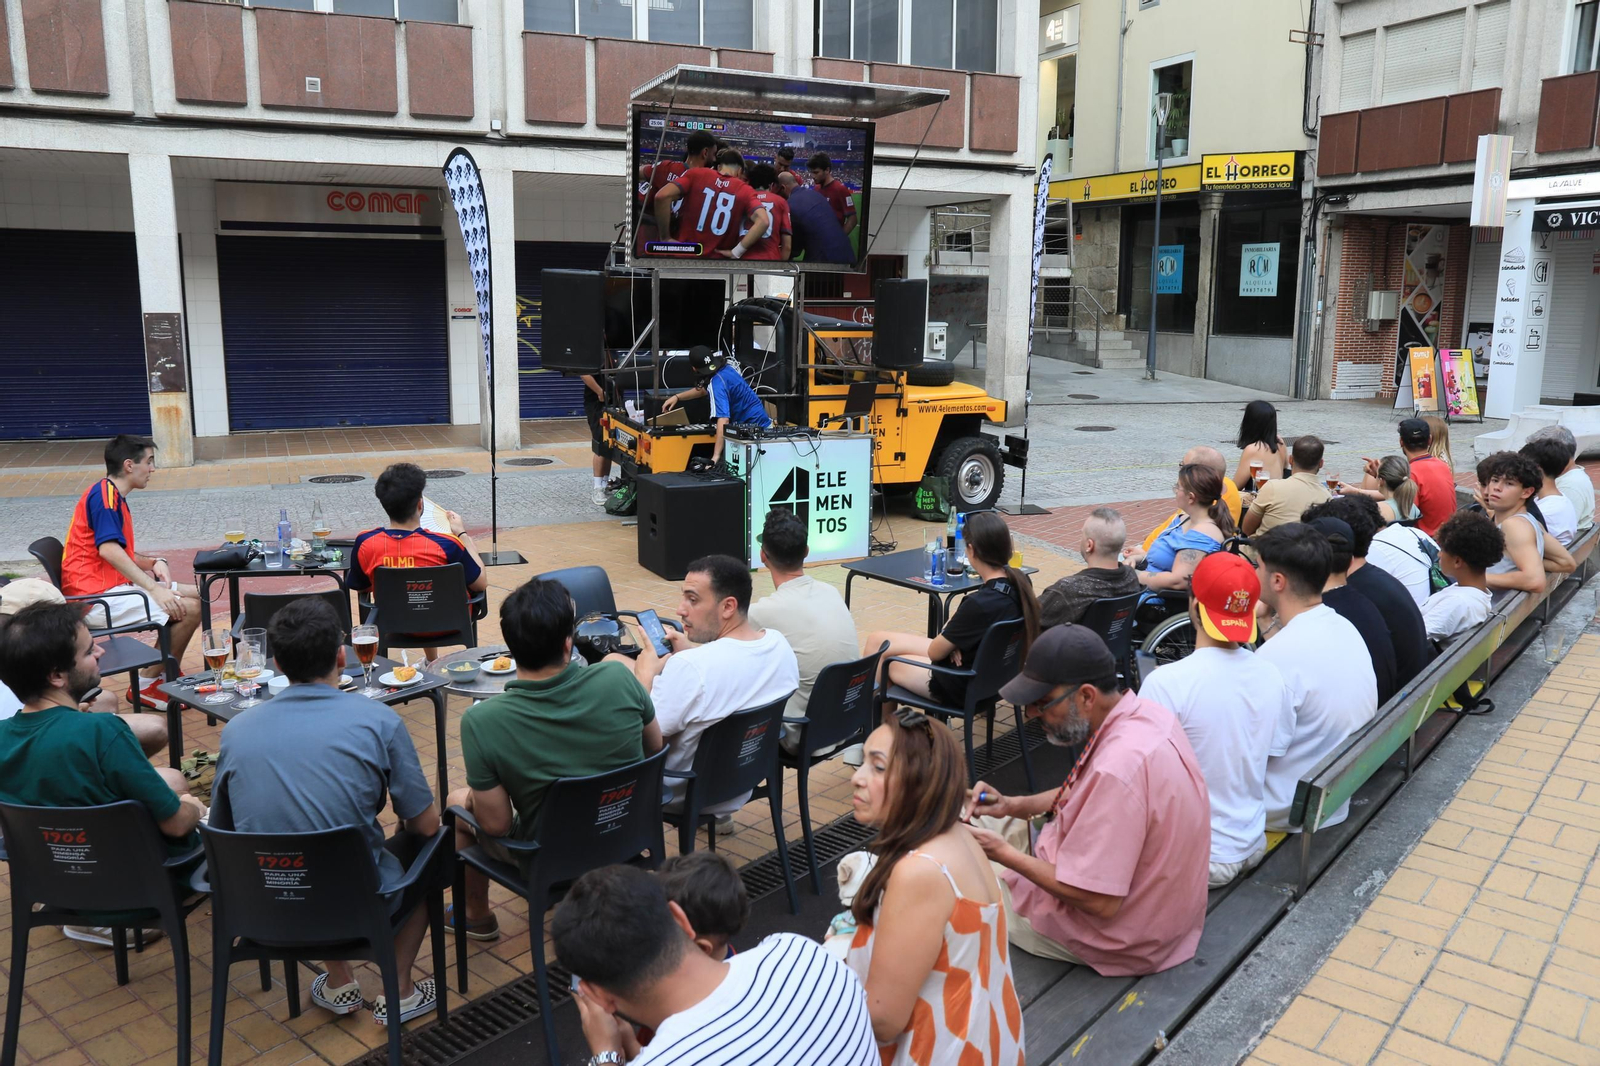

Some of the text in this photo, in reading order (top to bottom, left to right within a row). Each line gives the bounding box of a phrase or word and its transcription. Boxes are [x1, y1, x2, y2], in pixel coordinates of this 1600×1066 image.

[846, 140, 852, 150] 1
[1206, 162, 1290, 181] EL HORREO
[1130, 182, 1138, 192] EL
[327, 191, 430, 214] comar
[696, 187, 736, 236] 18
[1570, 210, 1600, 226] VIC
[1249, 256, 1269, 277] RCM
[816, 471, 847, 488] ELE
[816, 494, 852, 512] MEN
[816, 517, 847, 534] TOS
[383, 556, 415, 567] OLMO
[406, 582, 433, 591] 1906
[1221, 619, 1248, 628] ESPAÑA
[600, 783, 636, 805] 1906
[42, 830, 87, 844] 1906
[257, 856, 304, 868] 1906
